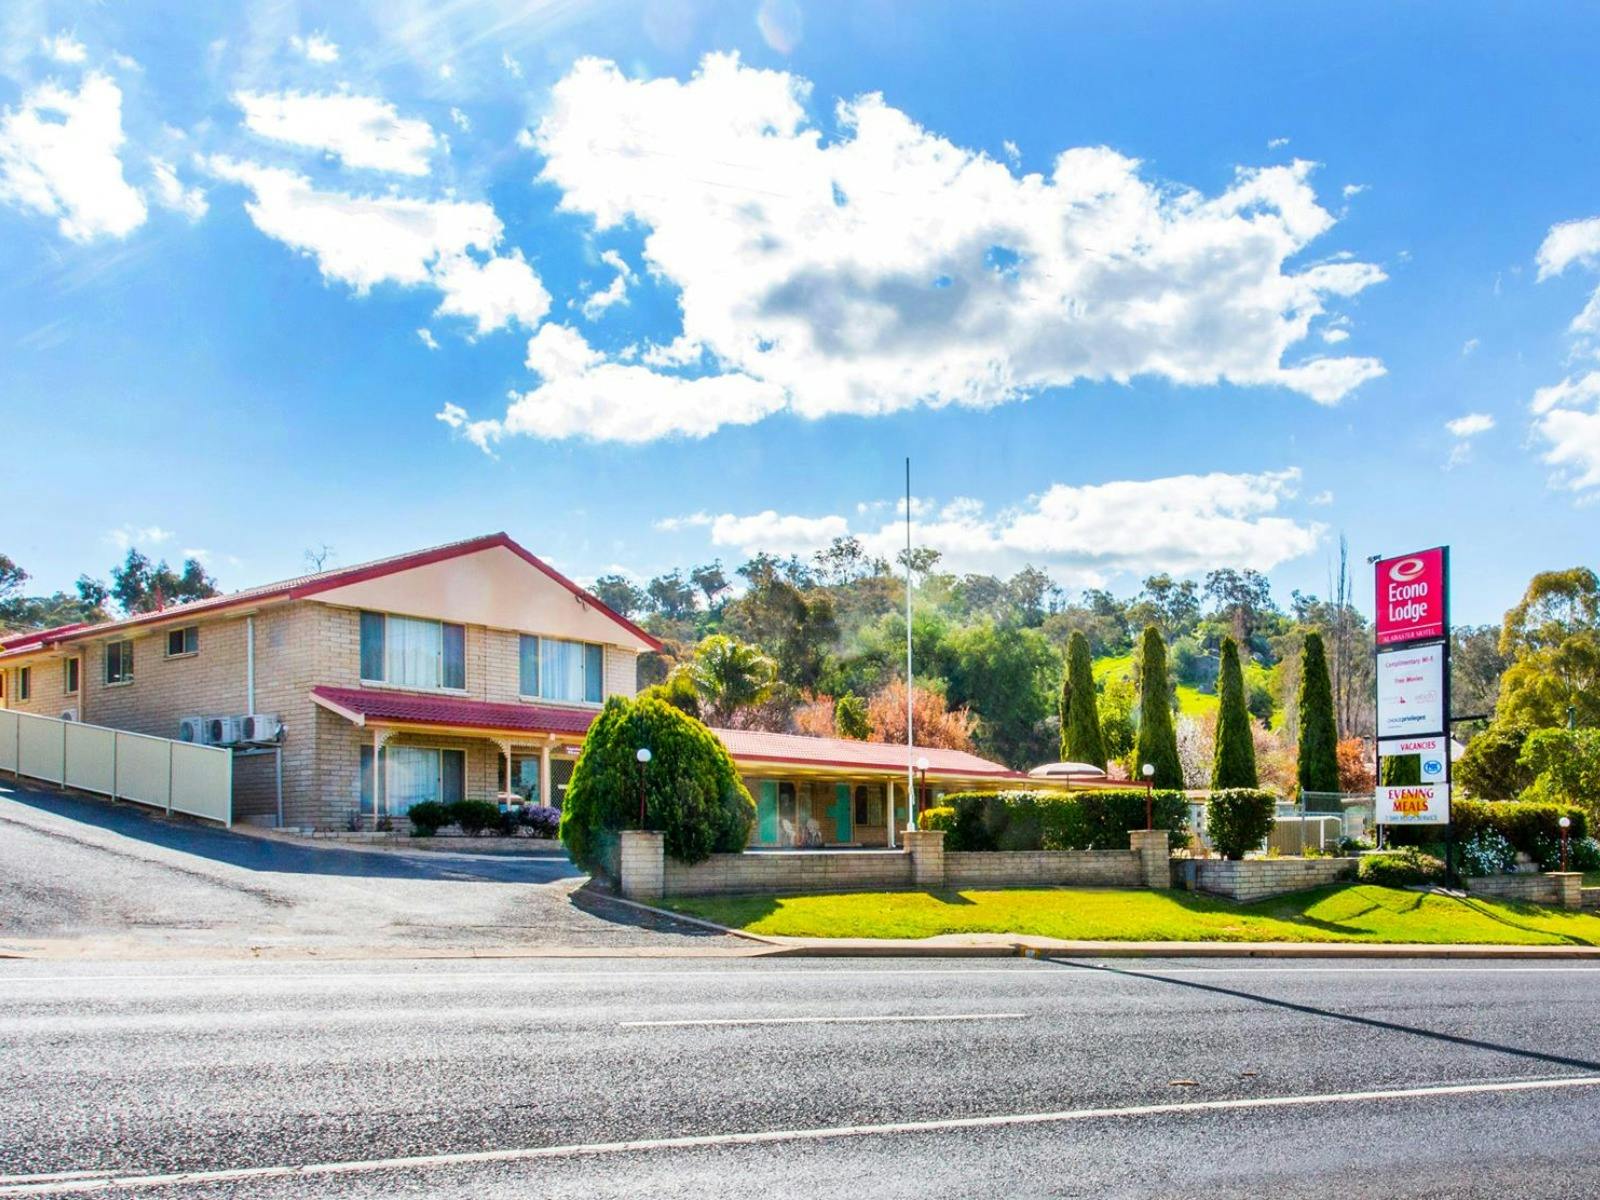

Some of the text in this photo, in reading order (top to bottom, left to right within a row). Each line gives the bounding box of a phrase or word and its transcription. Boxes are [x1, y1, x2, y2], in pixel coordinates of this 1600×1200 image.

[1388, 582, 1428, 602] Econo
[1389, 600, 1428, 623] Lodge
[1400, 741, 1437, 751] VACANCIES
[1388, 787, 1434, 800] EVENING
[1392, 801, 1429, 812] MEALS
